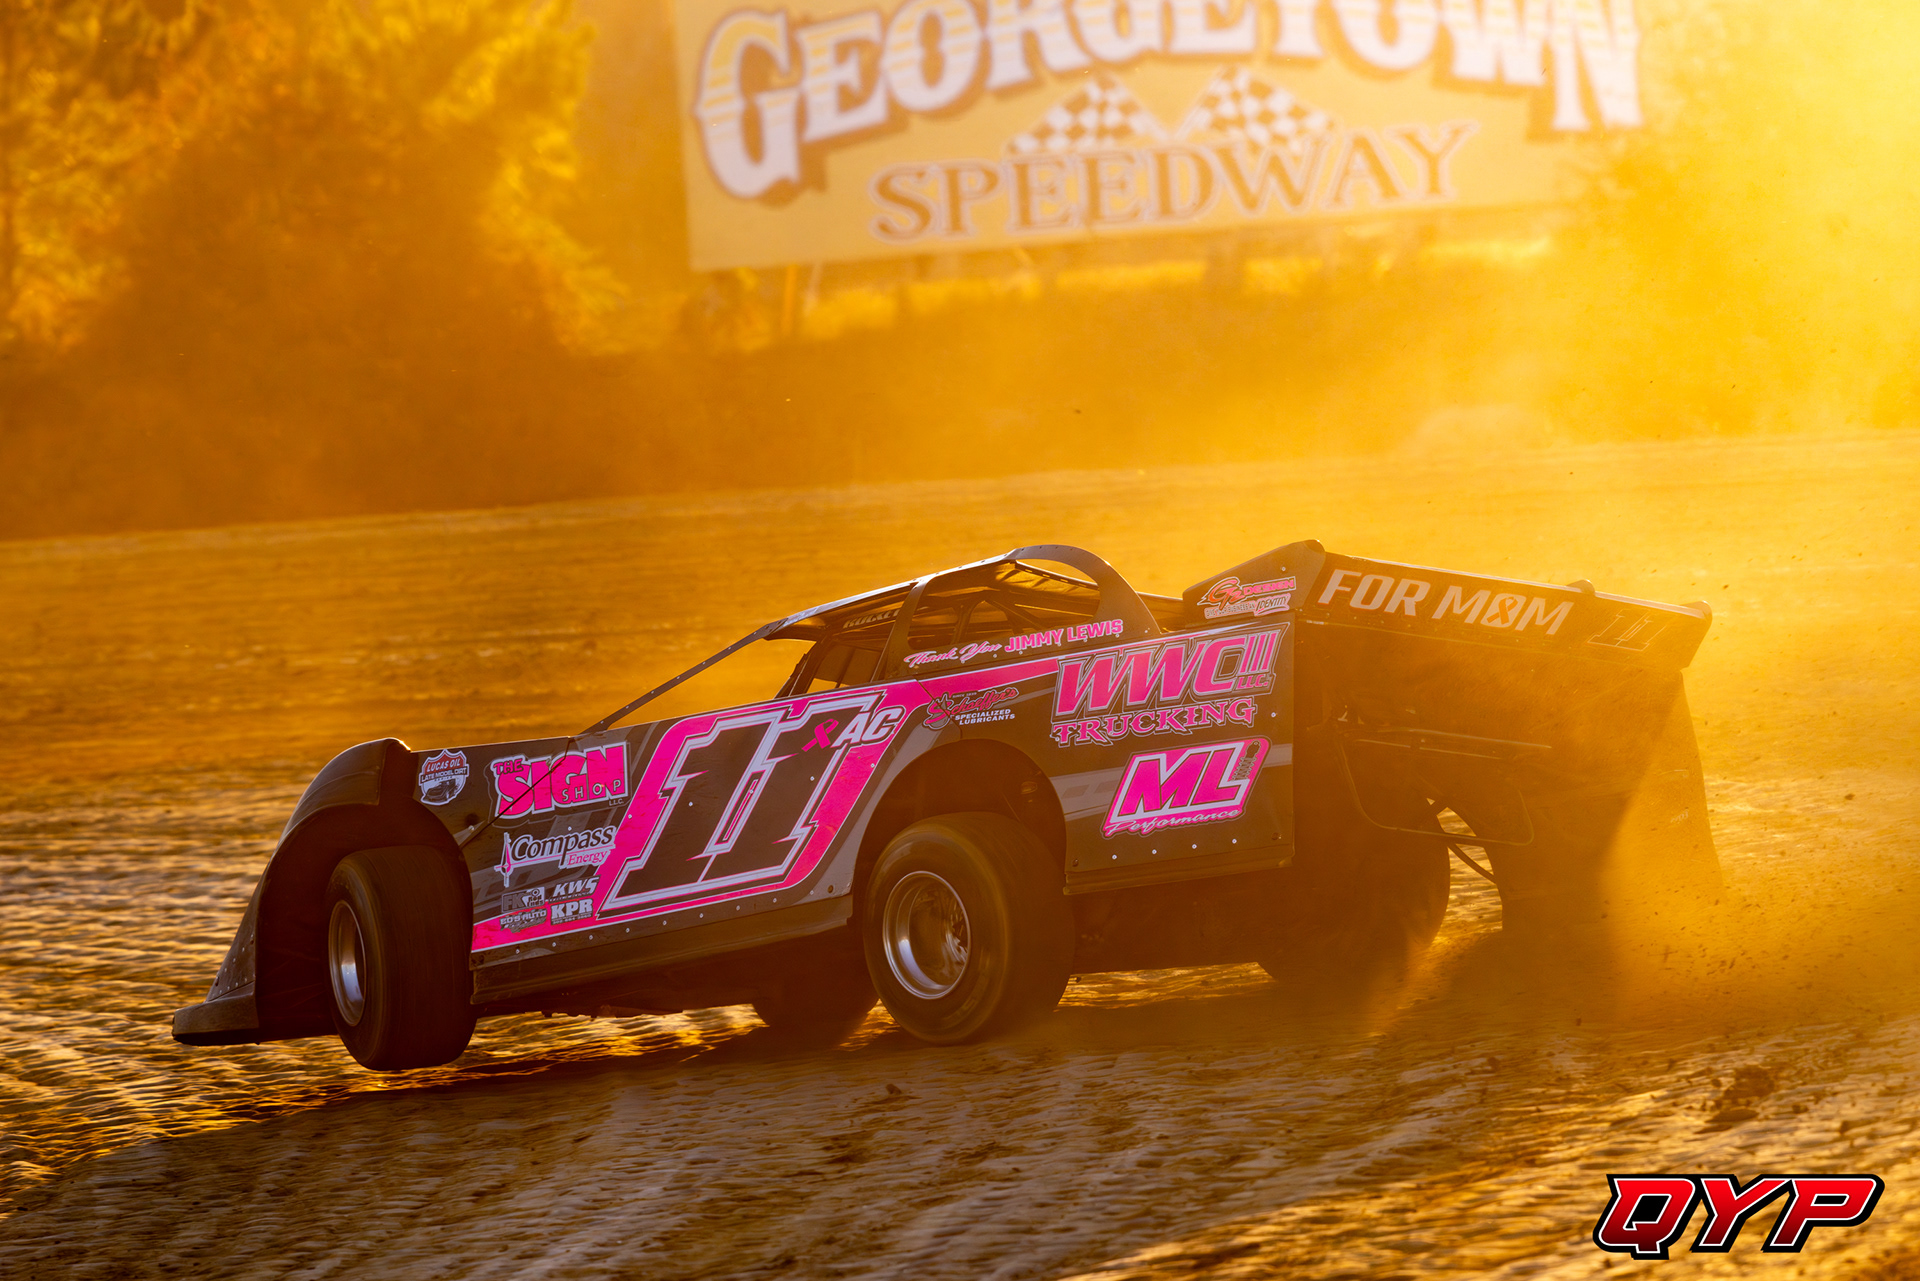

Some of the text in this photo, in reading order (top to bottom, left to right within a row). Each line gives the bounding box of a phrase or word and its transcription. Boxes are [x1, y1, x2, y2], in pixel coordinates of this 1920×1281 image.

[868, 121, 1480, 242] SPEEDWAY
[1242, 579, 1295, 596] DESIGN
[1317, 568, 1575, 636] FOR MOM
[903, 619, 1124, 668] Thank You JIMMY LEWIS
[829, 705, 906, 749] AC
[954, 708, 1012, 721] SPECIALIZED
[958, 713, 1016, 726] LUBRICANTS
[1053, 697, 1254, 744] TRUCKING
[426, 758, 461, 773] LUCAS OIL
[493, 758, 525, 775] THE
[496, 745, 627, 817] SIGN
[561, 779, 621, 802] SHOP
[1110, 742, 1250, 824] ML
[1105, 808, 1241, 836] Performance
[510, 826, 618, 866] Compass
[567, 850, 608, 867] Energy
[552, 877, 599, 898] KWS
[551, 899, 594, 919] KPR
